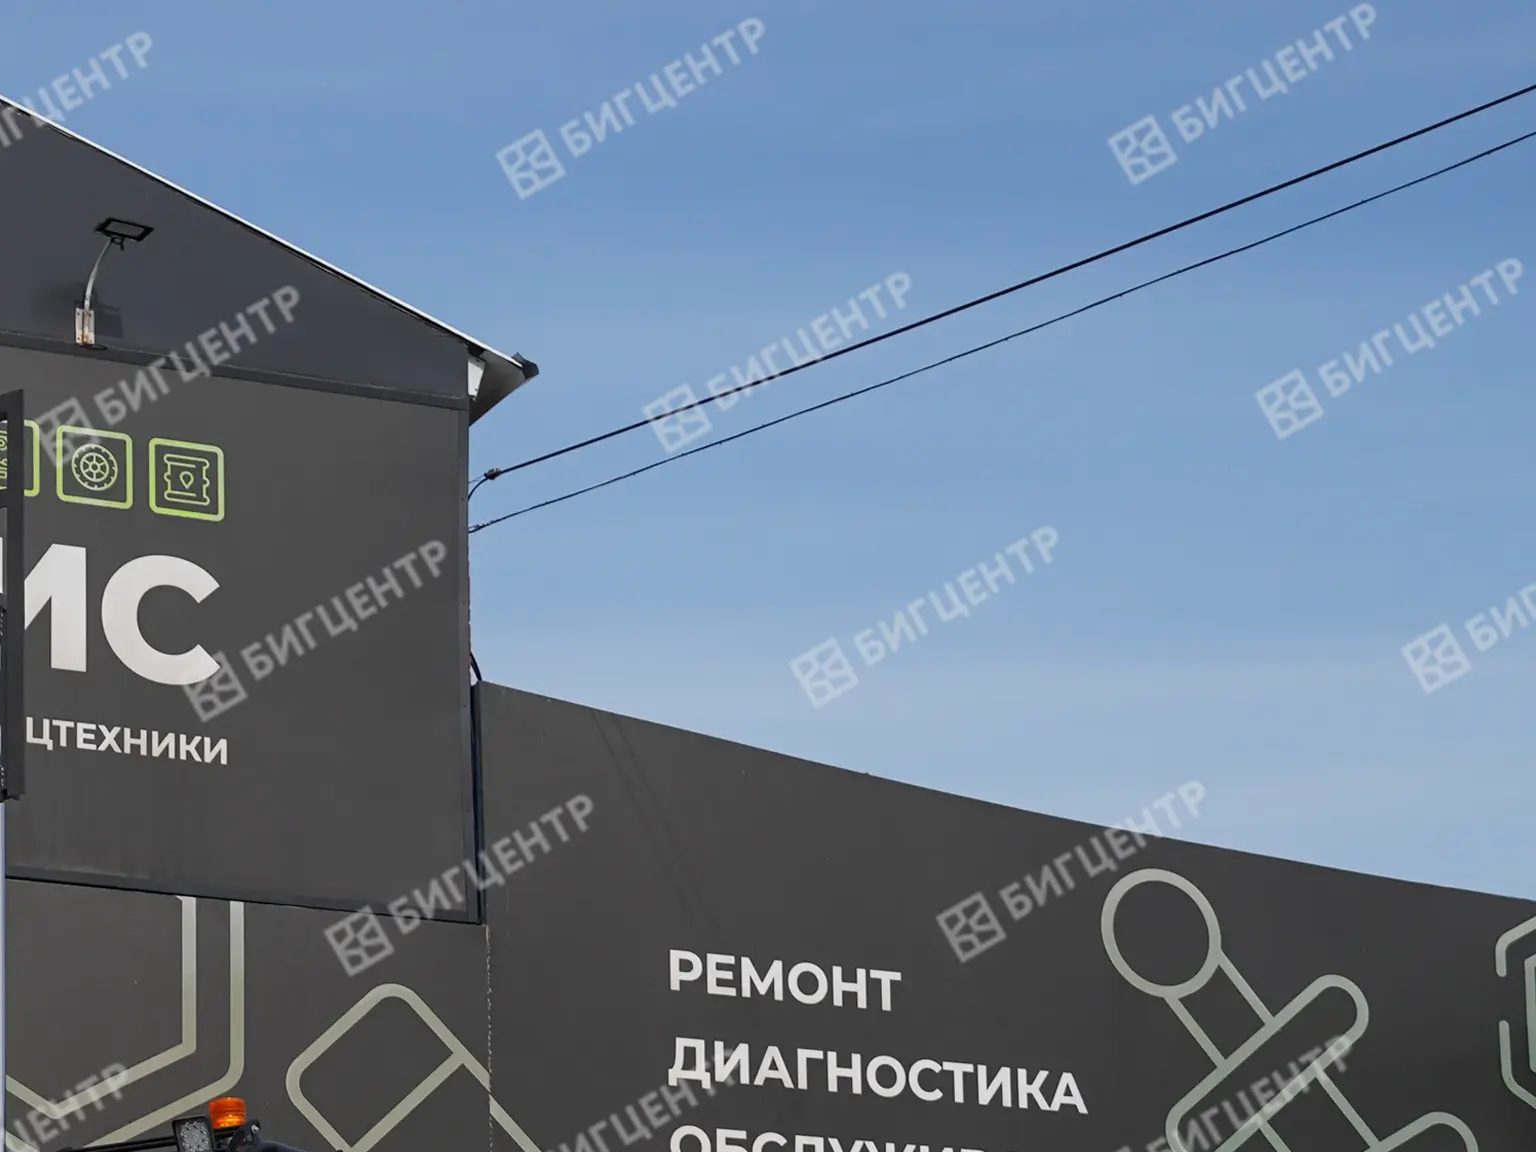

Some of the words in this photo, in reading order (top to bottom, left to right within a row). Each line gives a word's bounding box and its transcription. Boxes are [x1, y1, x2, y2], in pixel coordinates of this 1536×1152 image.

[25, 722, 229, 766] ЦТЕХНИКИ
[669, 948, 902, 1011] РЕМОНТ
[668, 1036, 1088, 1114] ДИАГНОСТИКА
